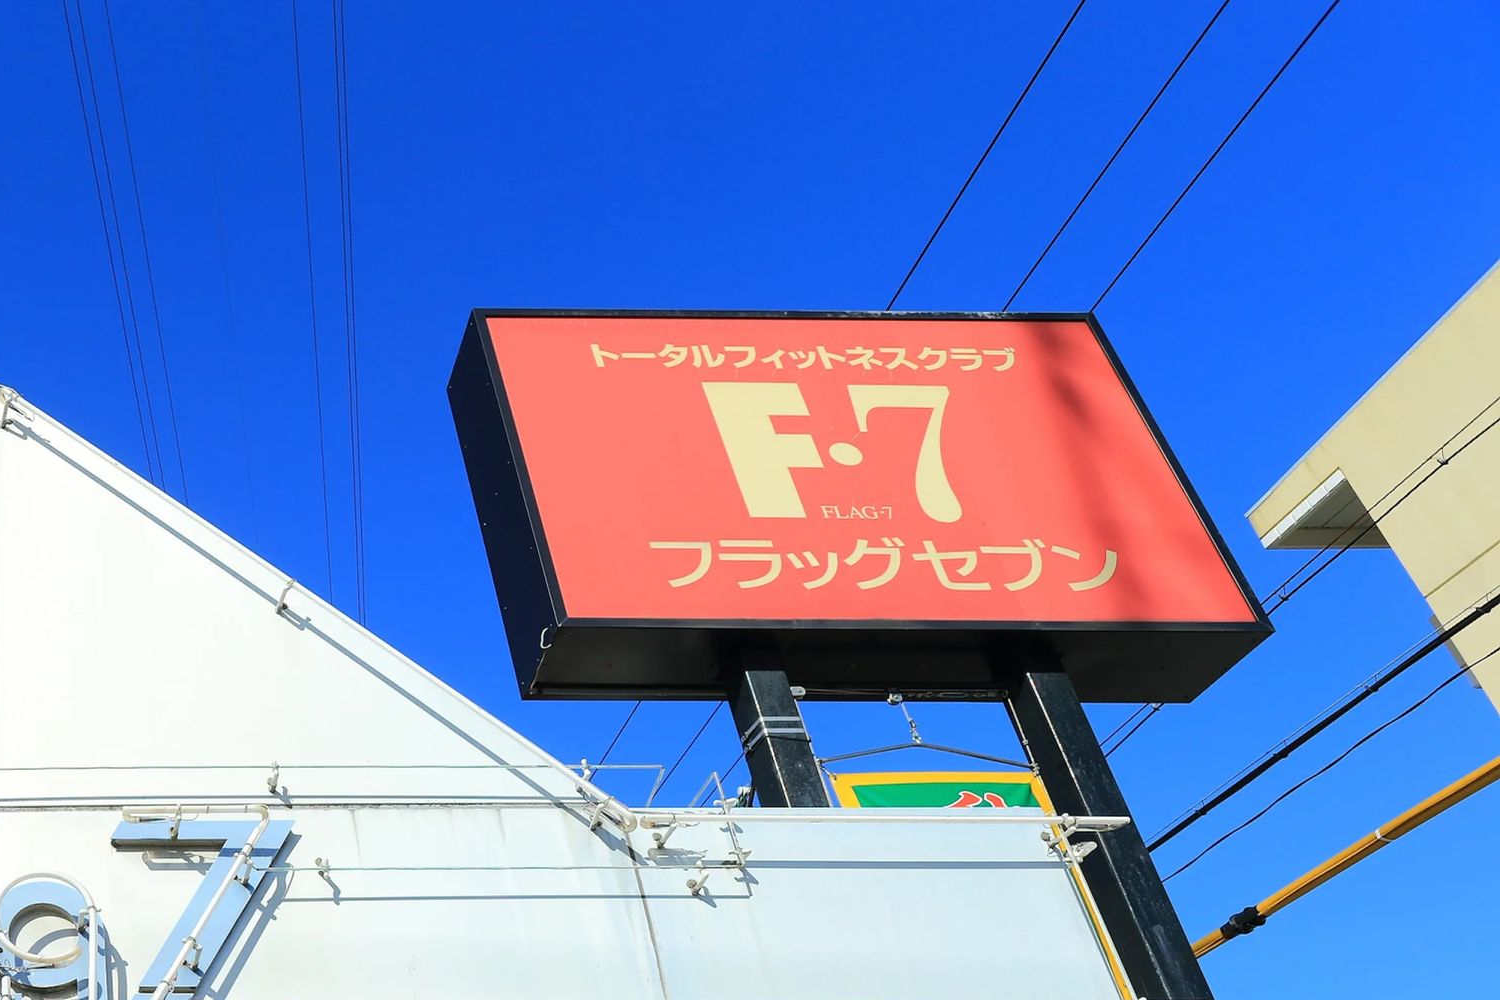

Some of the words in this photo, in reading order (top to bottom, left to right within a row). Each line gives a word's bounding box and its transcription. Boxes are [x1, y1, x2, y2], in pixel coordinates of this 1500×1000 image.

[590, 342, 1016, 372] トータルフィットネスクラブ
[648, 536, 1118, 592] フラッグセブン
